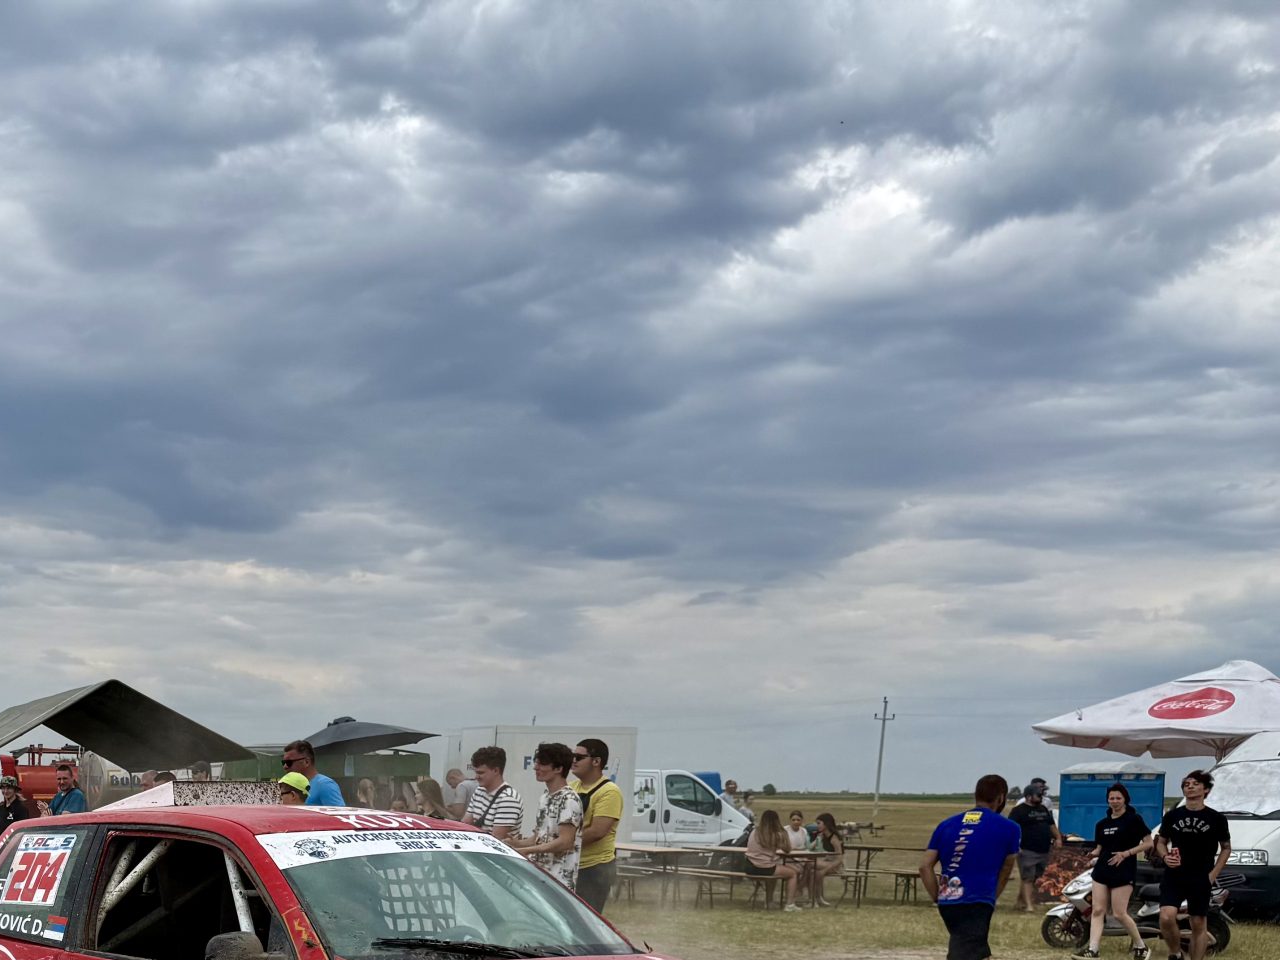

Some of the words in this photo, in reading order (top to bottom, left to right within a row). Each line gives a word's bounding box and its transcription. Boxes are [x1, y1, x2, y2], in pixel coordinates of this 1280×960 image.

[334, 814, 431, 829] KUM
[1172, 817, 1210, 833] TOSTER
[332, 832, 405, 845] AUTOCROSS
[404, 830, 475, 843] ASOCIJACIJA
[395, 840, 442, 850] SRBIJE
[4, 852, 67, 902] 204
[32, 919, 44, 936] D.
